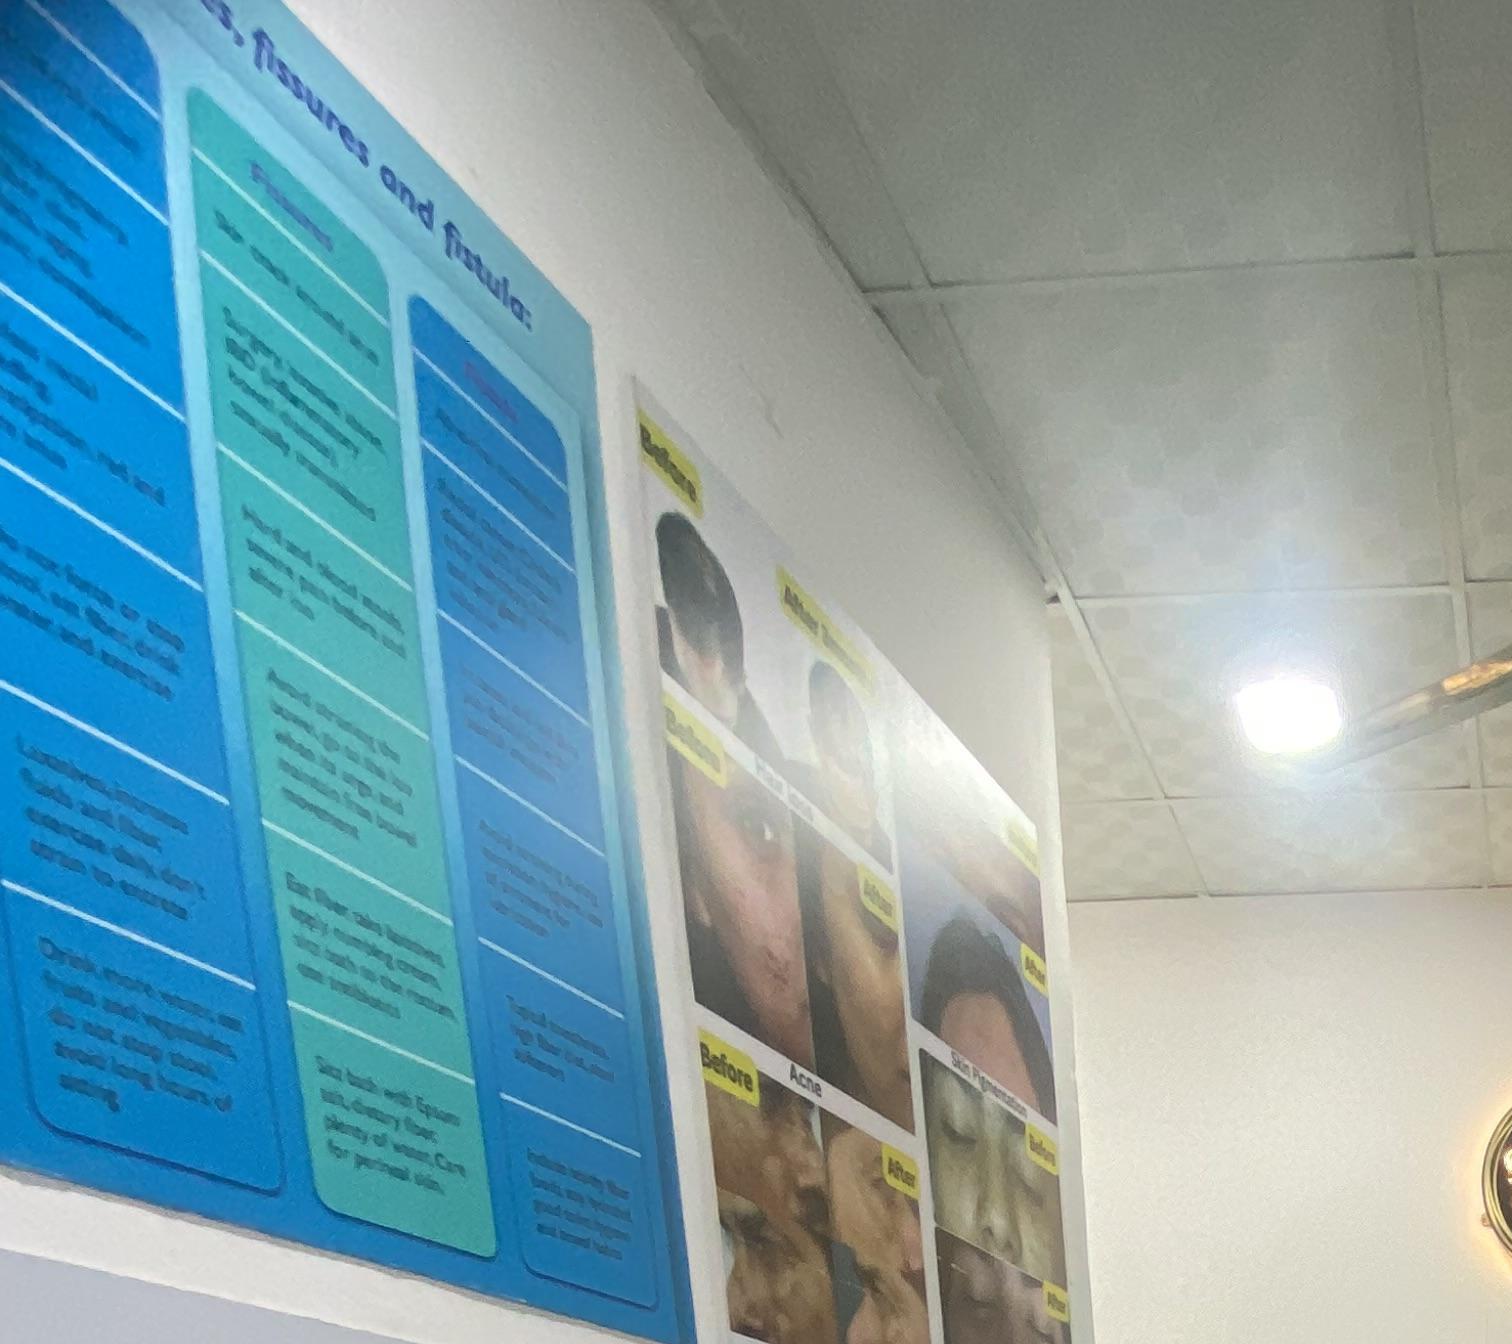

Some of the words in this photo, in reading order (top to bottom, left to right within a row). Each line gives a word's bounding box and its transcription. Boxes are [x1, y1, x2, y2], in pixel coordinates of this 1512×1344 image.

[253, 27, 369, 168] fissures
[380, 165, 434, 231] and
[699, 1041, 754, 1092] Before
[789, 1063, 823, 1098] Acne
